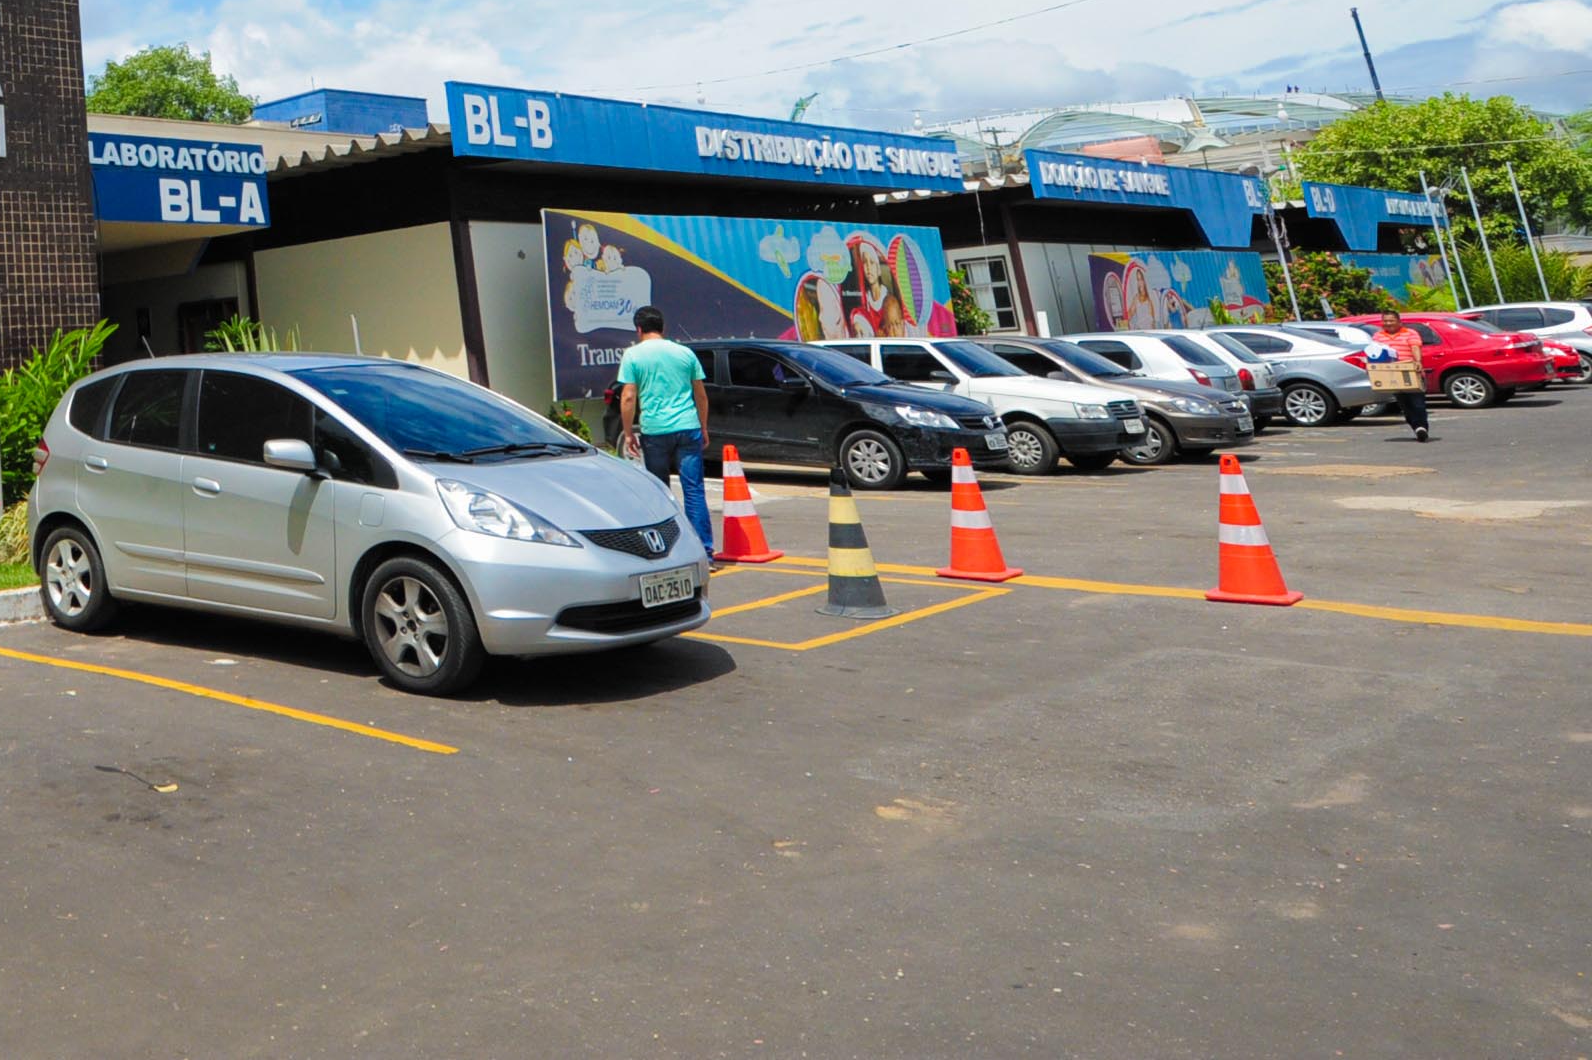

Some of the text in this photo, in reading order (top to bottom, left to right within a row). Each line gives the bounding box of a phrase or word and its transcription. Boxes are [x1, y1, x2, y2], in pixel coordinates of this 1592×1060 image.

[463, 93, 553, 149] BL-B
[88, 141, 267, 174] LABORATÓRIO
[696, 126, 962, 179] DISTRIBUIÇÃO DE SANGUE
[159, 178, 265, 224] BL-A
[1039, 160, 1171, 196] DOAÇÃO DE SANGUE
